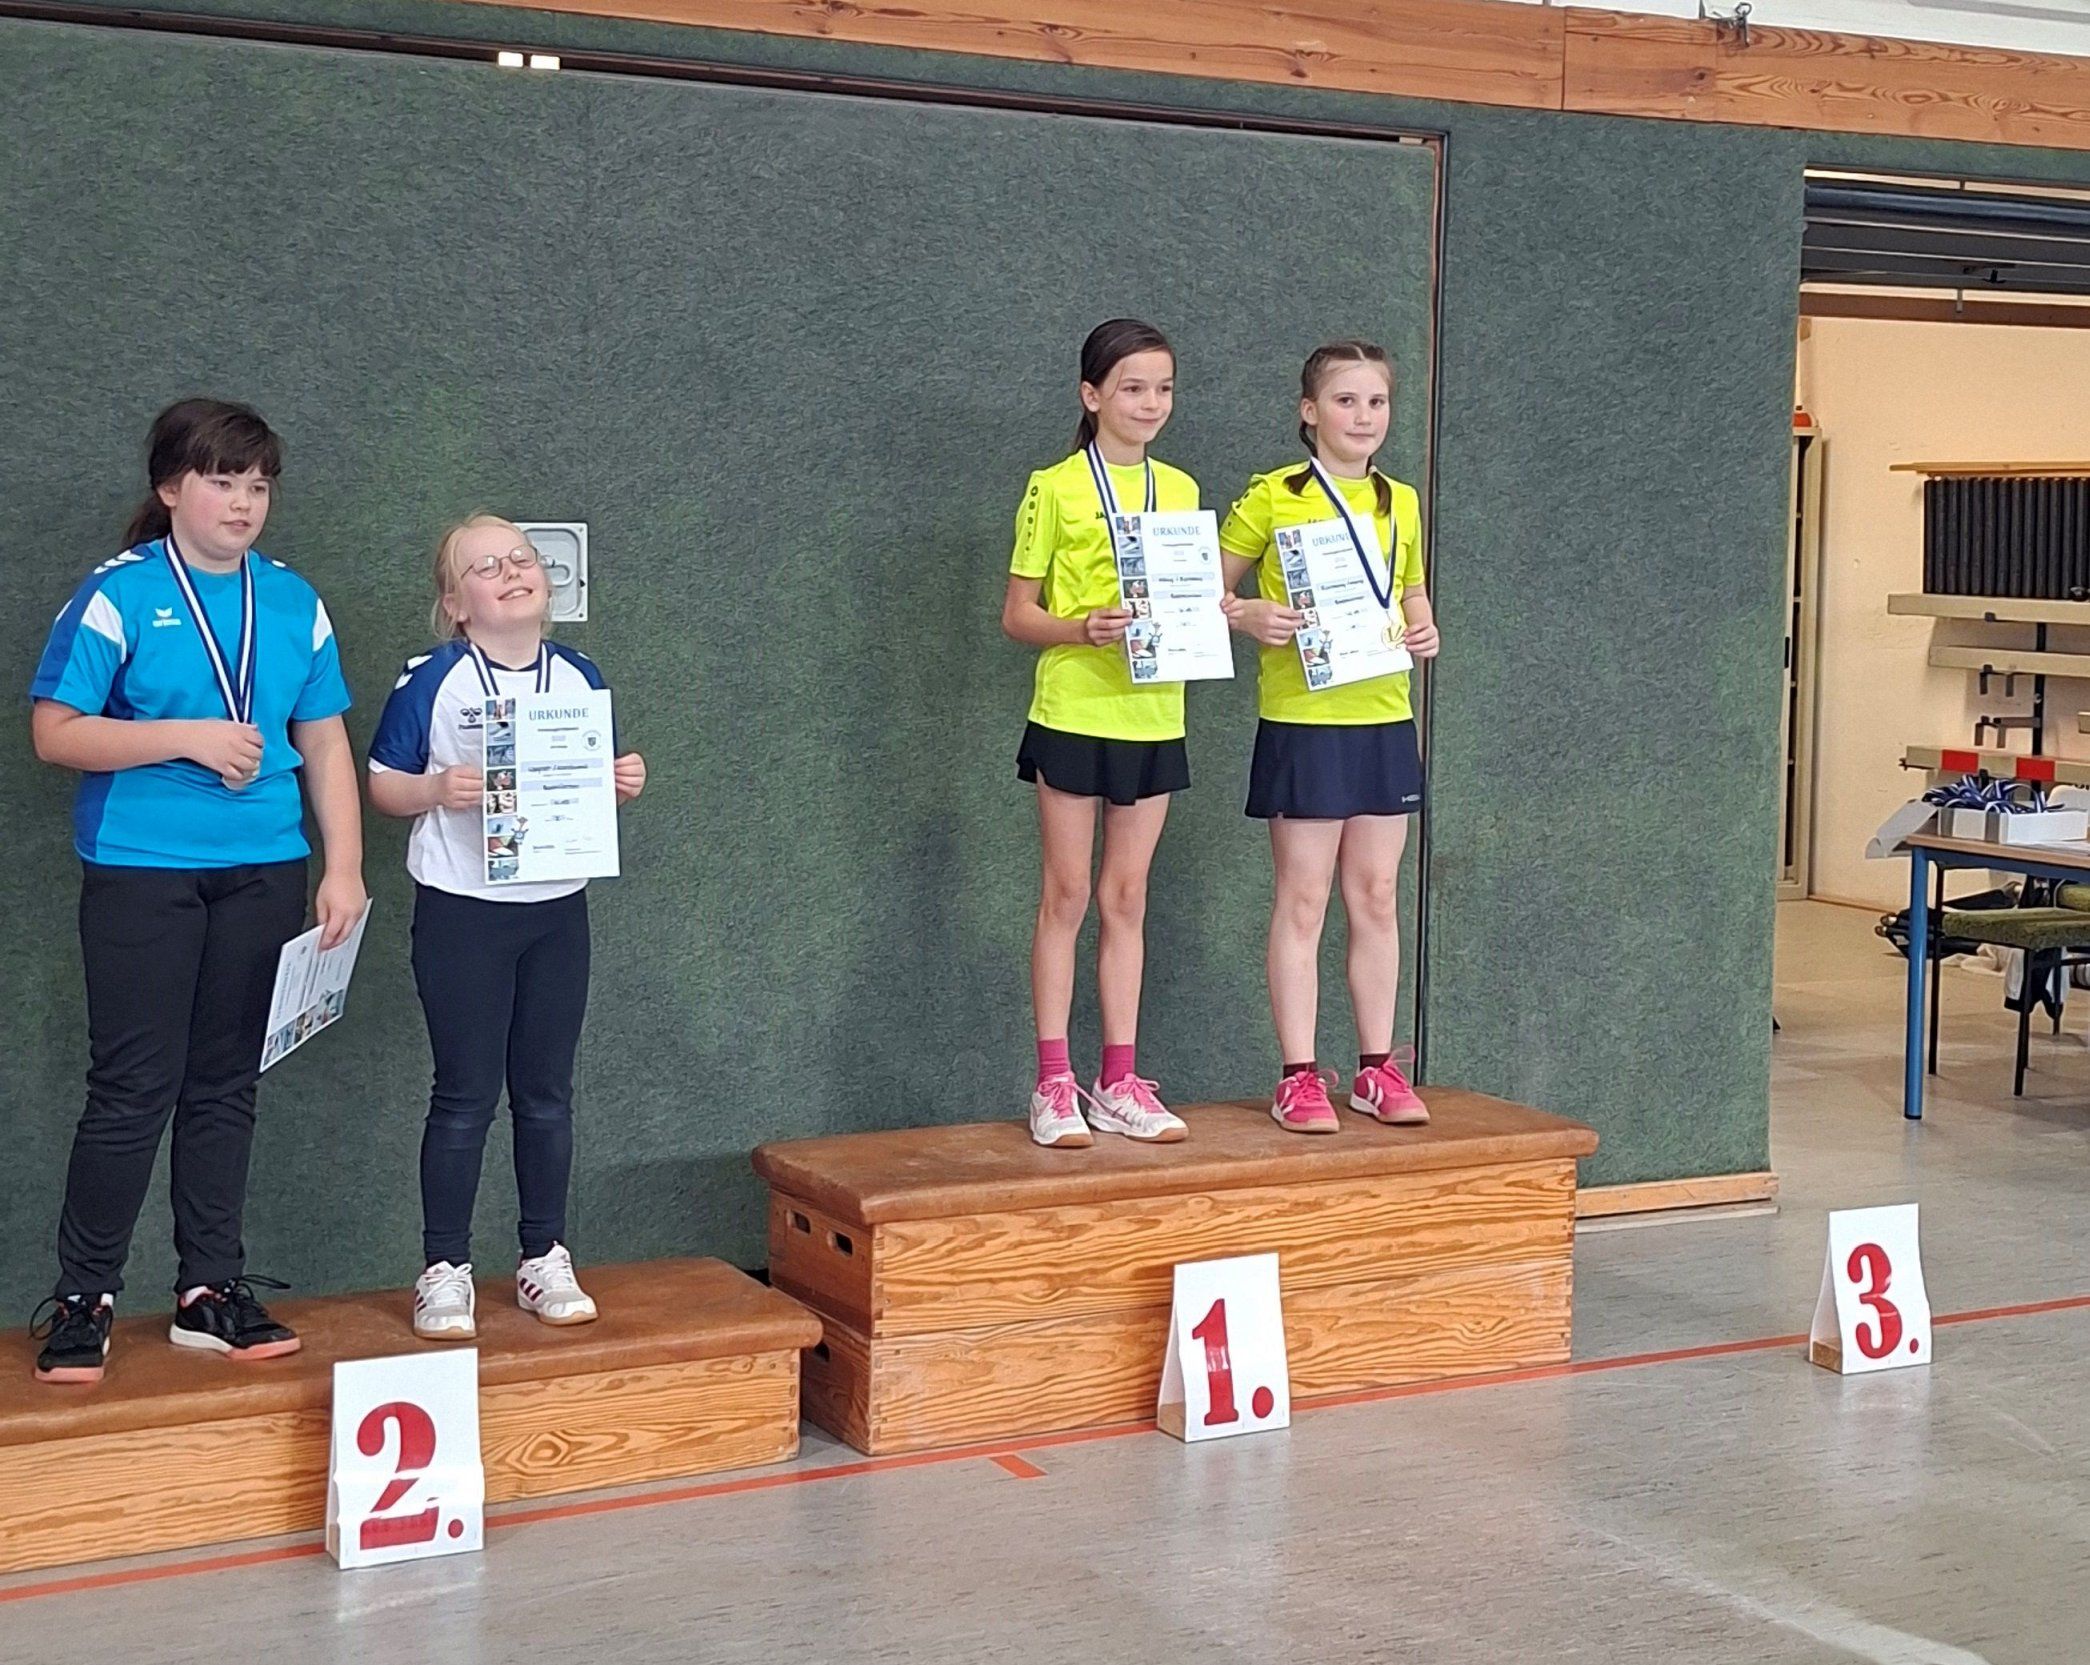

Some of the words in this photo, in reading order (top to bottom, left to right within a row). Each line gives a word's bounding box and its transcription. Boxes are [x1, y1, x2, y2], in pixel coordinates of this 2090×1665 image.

[1152, 526, 1201, 536] URKUNDE
[1311, 532, 1350, 547] URKUN
[529, 707, 589, 721] URKUNDE
[1846, 1243, 1918, 1360] 3.
[1191, 1299, 1274, 1425] 1.
[356, 1402, 463, 1550] 2.
